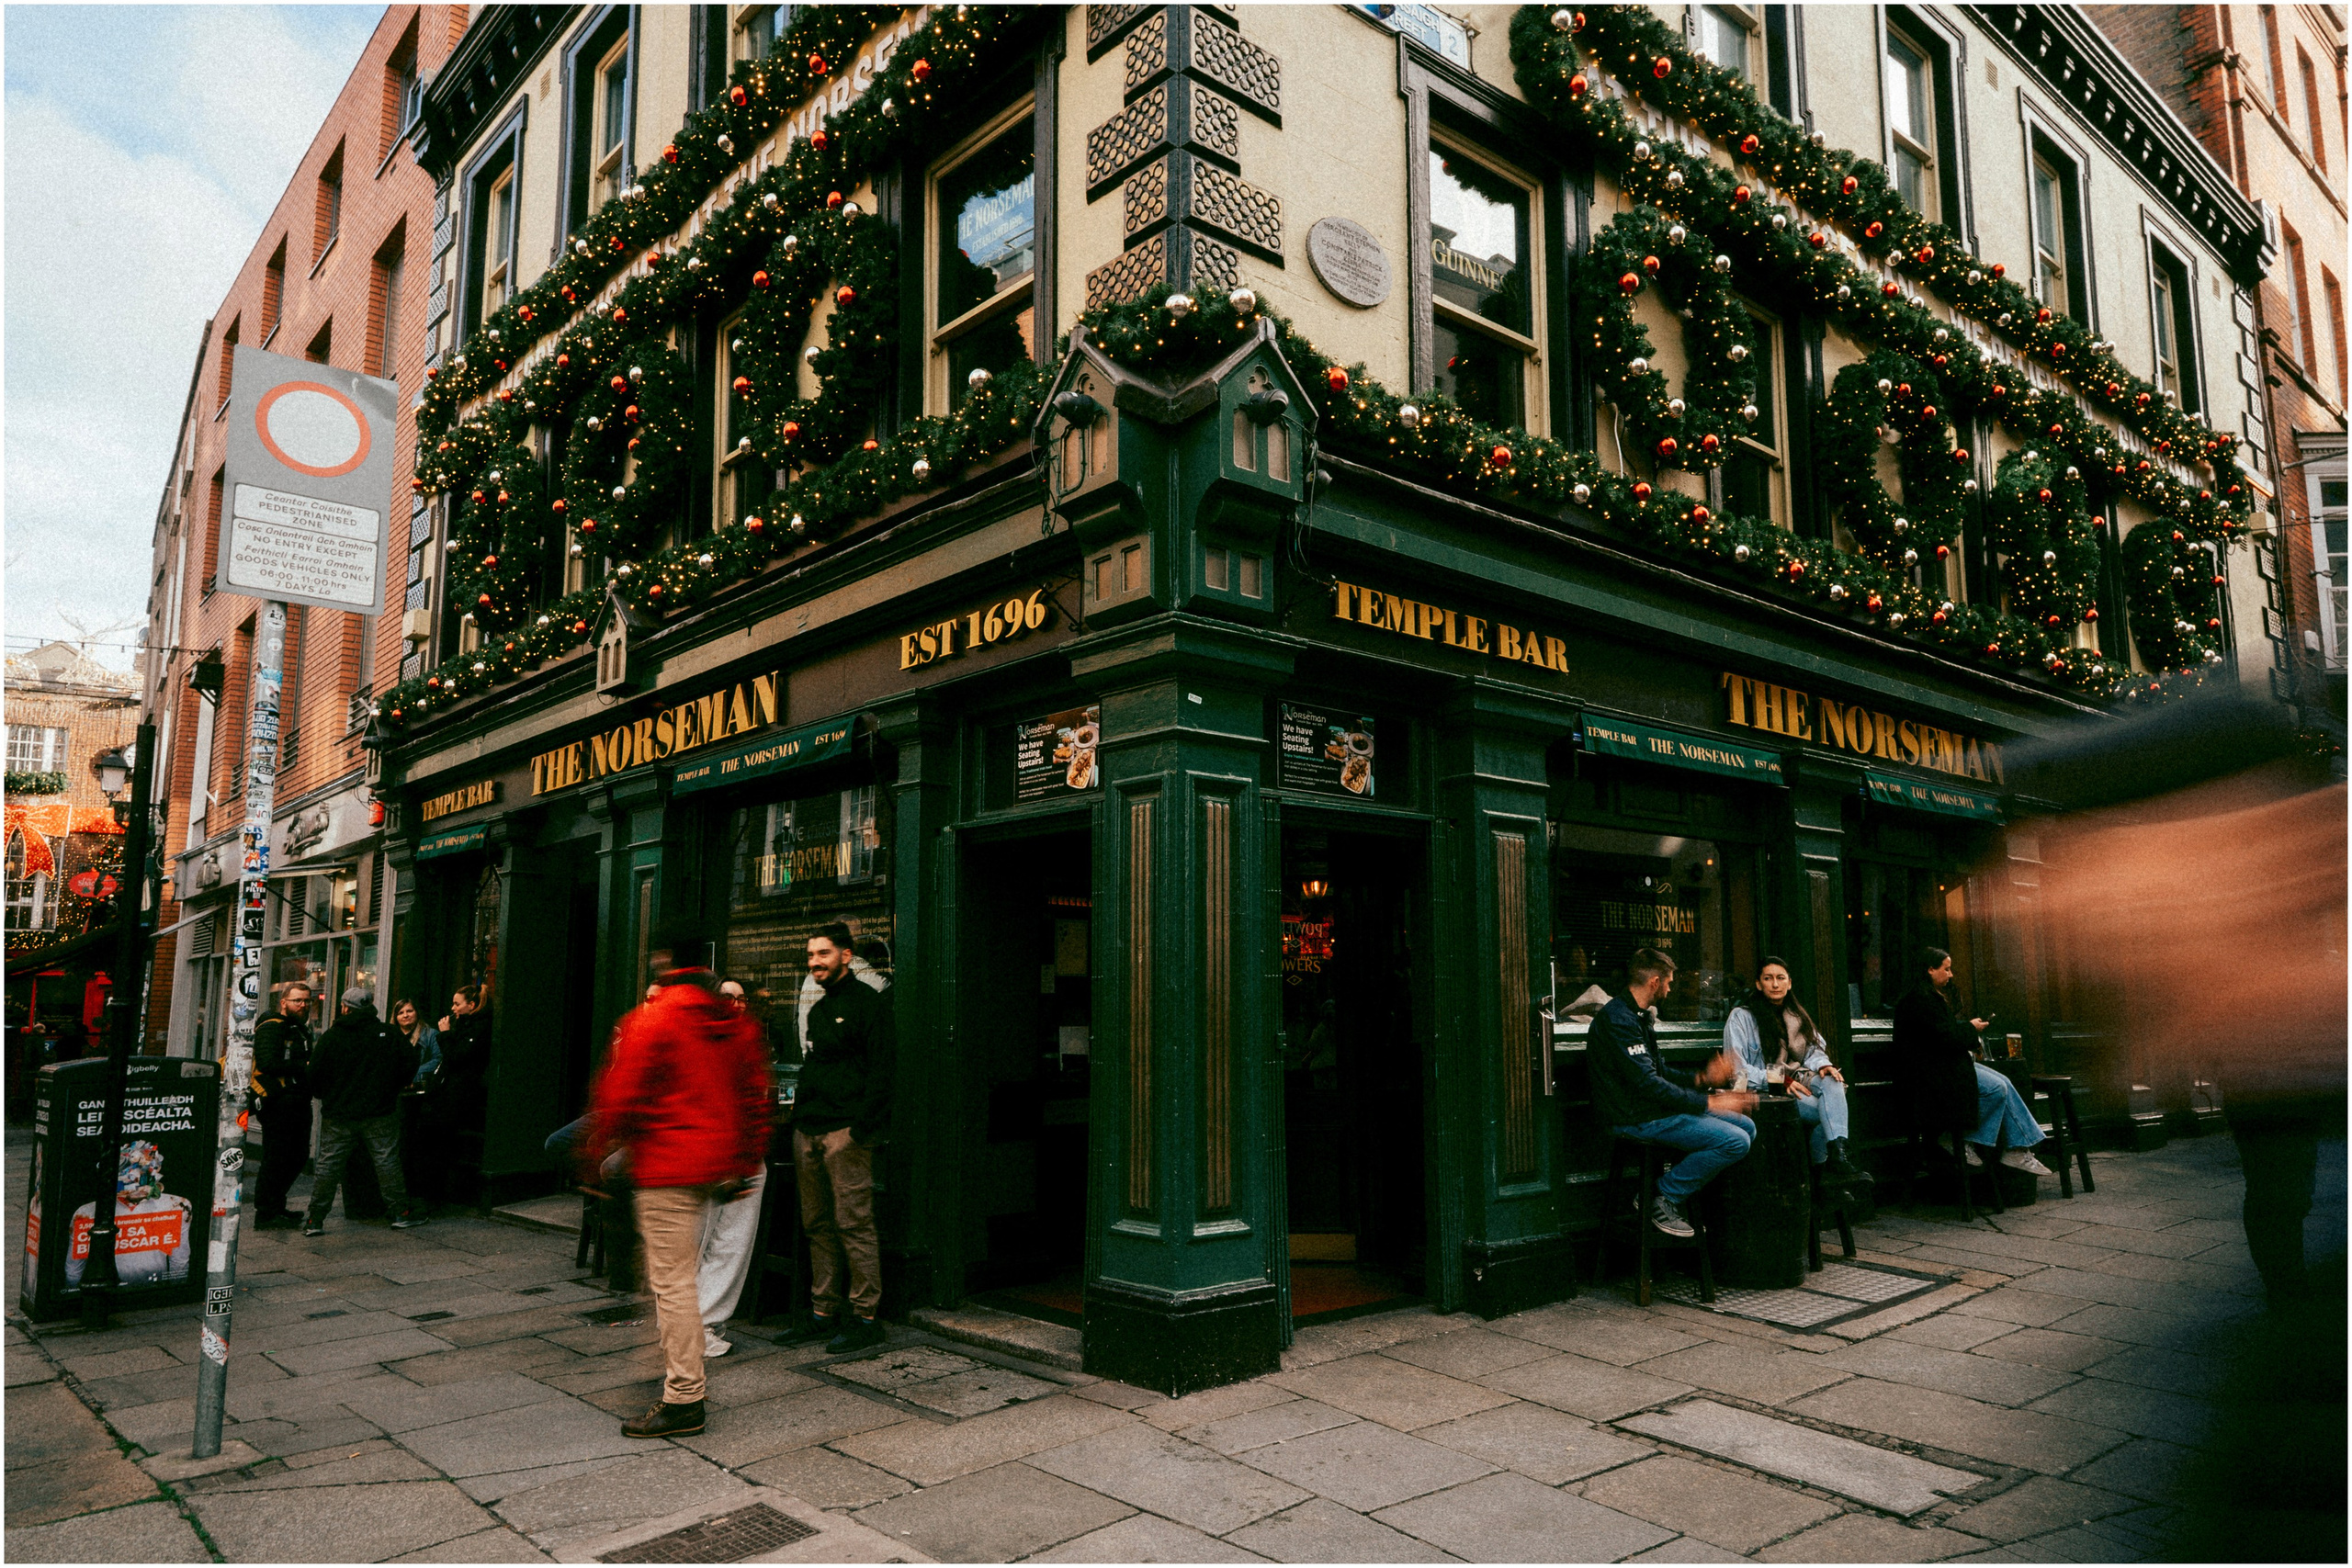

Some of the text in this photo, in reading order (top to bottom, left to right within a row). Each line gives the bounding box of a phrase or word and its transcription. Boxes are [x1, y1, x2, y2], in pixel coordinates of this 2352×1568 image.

[1448, 33, 1458, 56] 2
[258, 502, 357, 526] PEDESTRIANISED
[292, 516, 323, 529] ZONE
[238, 522, 263, 533] Cosc
[254, 535, 357, 559] NO ENTRY EXCEPT
[235, 553, 370, 582] GOODS VEHICLES ONLY
[260, 569, 293, 581] 06:00
[301, 576, 329, 587] 11:00
[331, 581, 346, 590] hrs
[285, 581, 314, 593] DAYS
[899, 588, 1046, 671] EST 1696
[1332, 580, 1570, 673] TEMPLE BAR
[530, 671, 779, 797] THE NORSEMAN
[1283, 723, 1313, 736] We have
[1720, 671, 2005, 785] THE NORSEMAN
[1018, 740, 1044, 751] We have
[1283, 733, 1309, 745] Seating
[1283, 742, 1314, 753] Upstairs!
[1587, 726, 1620, 742] TEMPLE
[1621, 733, 1637, 746] BAR
[1648, 737, 1676, 756] THE
[1679, 742, 1746, 769] NORSEMAN
[1755, 759, 1768, 770] EST
[676, 770, 698, 782] TEMPLE
[698, 766, 710, 777] BAR
[720, 757, 741, 774] THE
[743, 739, 801, 768] NORSEMAN
[814, 734, 830, 746] EST
[1018, 750, 1040, 760] Seating
[1018, 756, 1044, 769] Upstairs!
[259, 765, 273, 774] SUS
[422, 780, 494, 822] TEMPLE BAR
[1910, 786, 1929, 800] THE
[753, 840, 852, 887] THE NORSEMAN
[1600, 900, 1695, 933] THE NORSEMAN
[1627, 1043, 1646, 1055] HH
[78, 1100, 105, 1110] GAN
[220, 1150, 243, 1168] SAVS
[127, 1226, 146, 1237] SA
